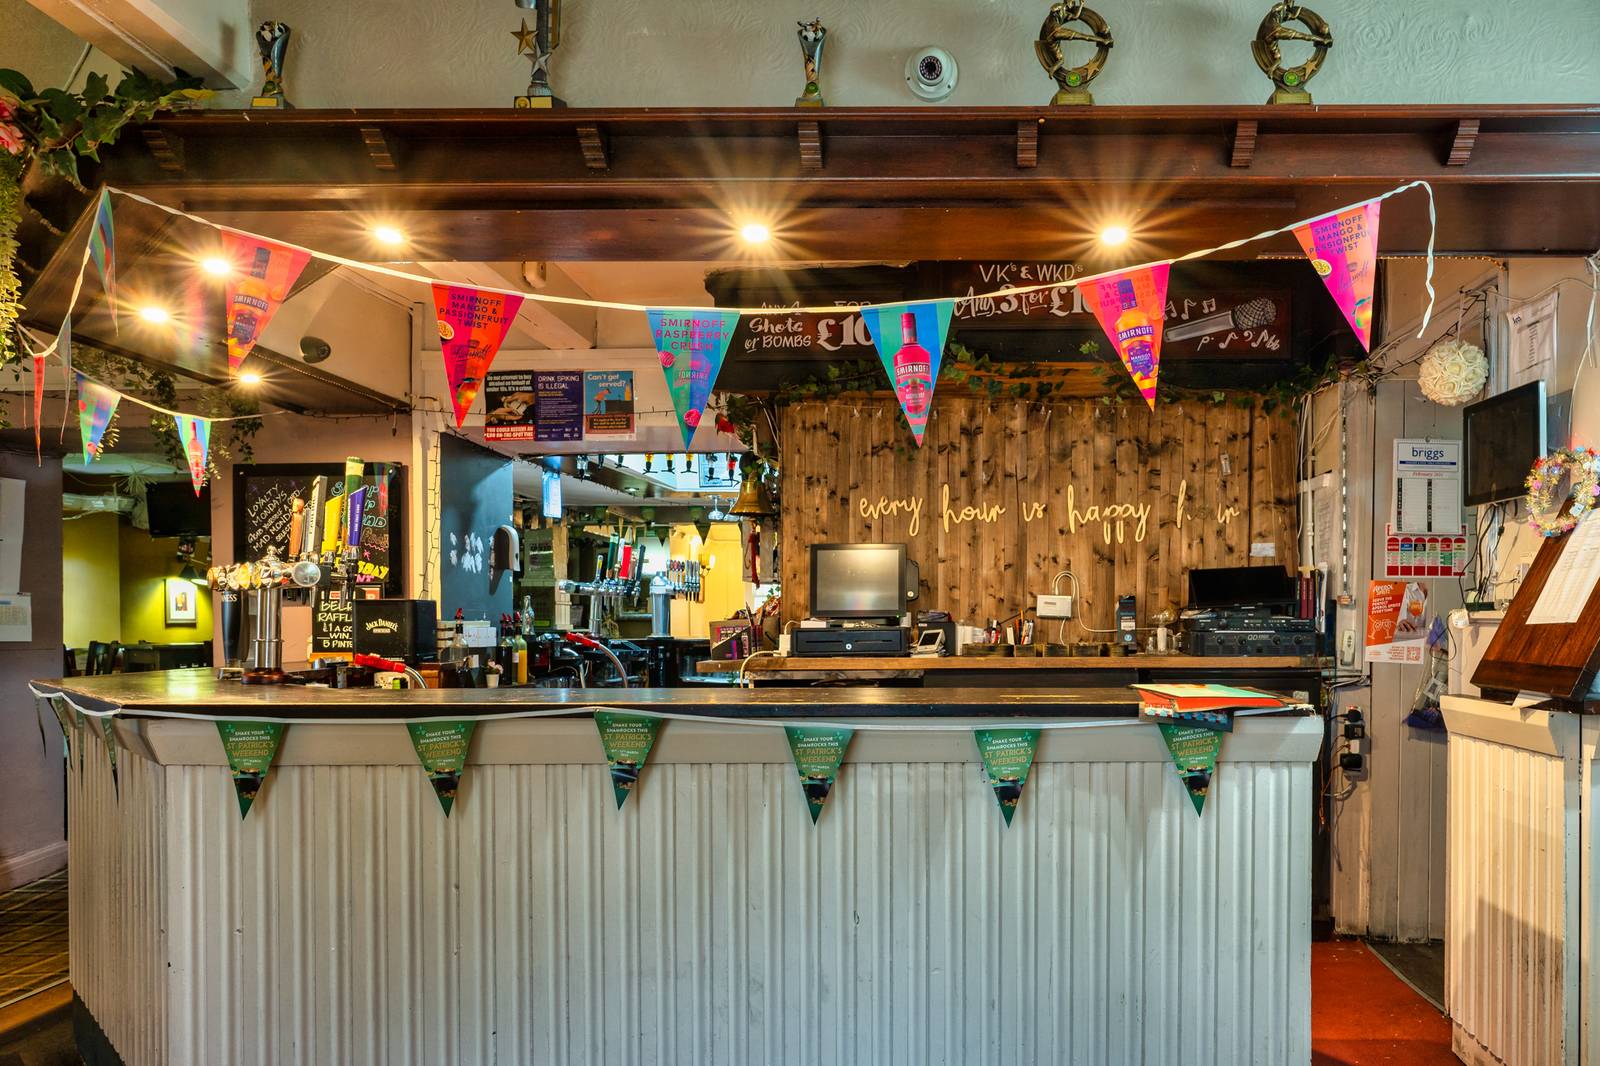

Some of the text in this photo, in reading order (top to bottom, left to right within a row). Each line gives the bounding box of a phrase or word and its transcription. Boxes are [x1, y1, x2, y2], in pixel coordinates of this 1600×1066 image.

[1314, 214, 1363, 235] SMIRNOFF
[1318, 223, 1363, 242] MANGO &
[1308, 229, 1372, 254] PASSIONFRU
[1329, 241, 1360, 255] TWIST
[1020, 265, 1034, 281] &
[451, 294, 502, 307] SMIRNOFF
[954, 286, 997, 319] Any
[999, 283, 1019, 313] 3
[1020, 290, 1049, 316] for
[451, 302, 499, 315] MANGO &
[439, 307, 510, 325] PASSIONFRUIT
[457, 318, 490, 330] TWIST
[660, 319, 726, 329] SMIRNOFF
[749, 317, 805, 334] Shots
[655, 330, 731, 341] RASPBERRY
[1118, 326, 1154, 342] SMIRNOFF
[670, 341, 714, 351] CRUSH
[762, 335, 812, 349] BOMBS
[896, 363, 930, 377] SMIRNOFF
[557, 375, 580, 383] SPIKING
[608, 374, 620, 382] get
[546, 382, 569, 390] ILLEGAL
[599, 380, 626, 388] served?
[1411, 446, 1445, 461] briggs
[247, 483, 279, 518] LOYALTY
[252, 490, 288, 527] MONDAYS
[858, 495, 925, 538] every
[941, 483, 1006, 534] hour
[1021, 500, 1046, 523] is
[1066, 484, 1152, 545] happy
[253, 534, 271, 552] MAD
[269, 508, 293, 535] MONDA
[318, 612, 353, 622] RAFFL
[329, 632, 350, 640] WIN
[323, 639, 330, 648] 5
[615, 733, 652, 741] PATRICK'S
[1172, 734, 1202, 743] SHAMROCKS
[1183, 736, 1219, 748] PATRICK'S
[239, 741, 274, 750] PATRICK'S
[429, 740, 466, 750] PATRICK'S
[608, 741, 647, 749] WEEKEND
[232, 749, 269, 758] WEEKEND
[427, 749, 461, 758] WEEKEND
[806, 747, 842, 755] PATRICK'S
[995, 748, 1032, 758] PATRICK'S
[1177, 745, 1214, 757] WEEKEND
[800, 755, 837, 763] WEEKEND
[990, 756, 1027, 766] WEEKEND
